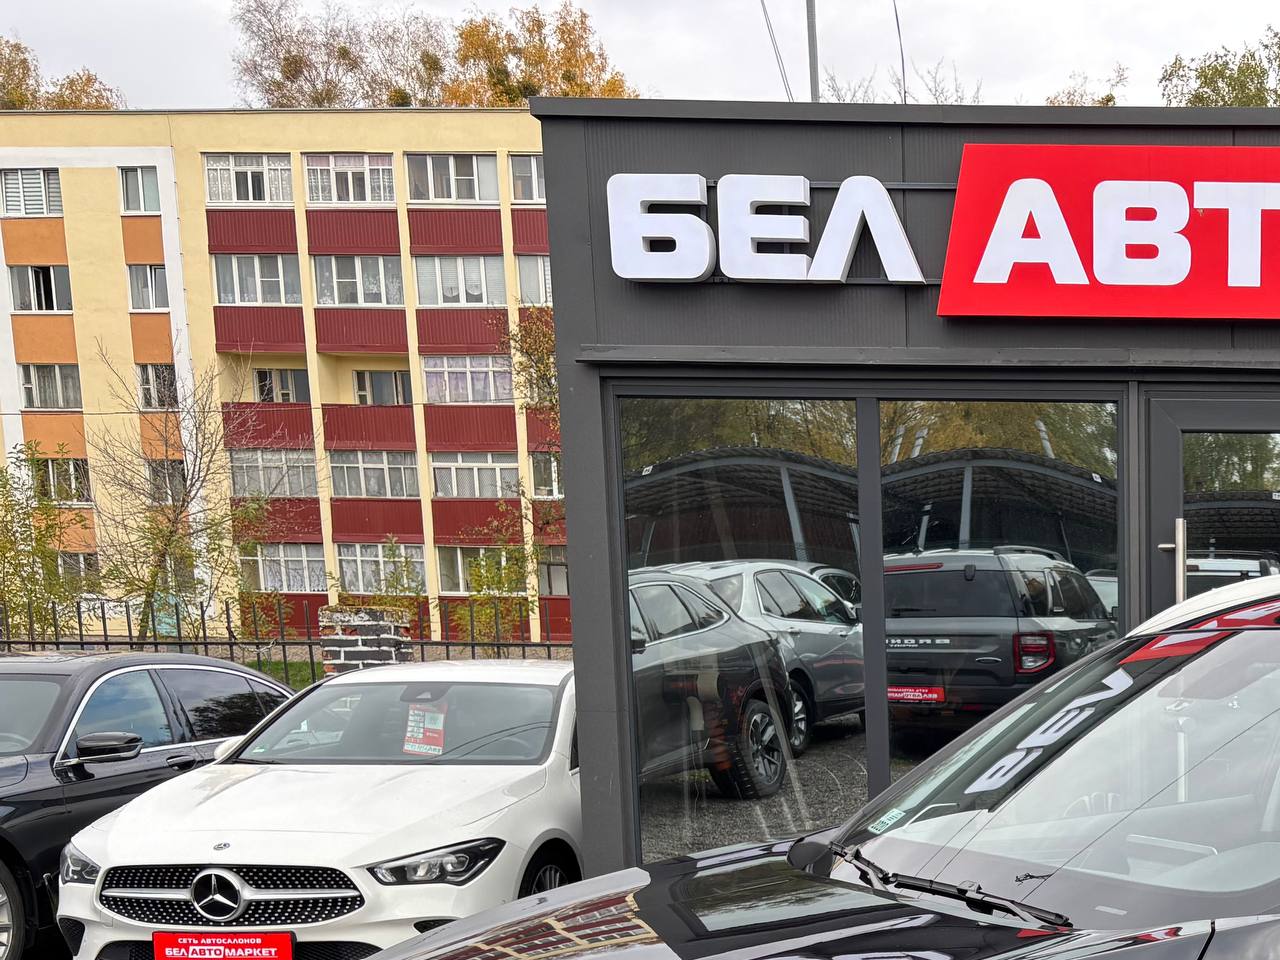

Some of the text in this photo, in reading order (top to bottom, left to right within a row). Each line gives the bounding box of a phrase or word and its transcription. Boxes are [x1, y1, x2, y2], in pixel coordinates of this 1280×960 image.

[607, 173, 926, 285] БЕЛ
[190, 948, 223, 956] АВТО
[225, 948, 278, 956] МАРКЕТ
